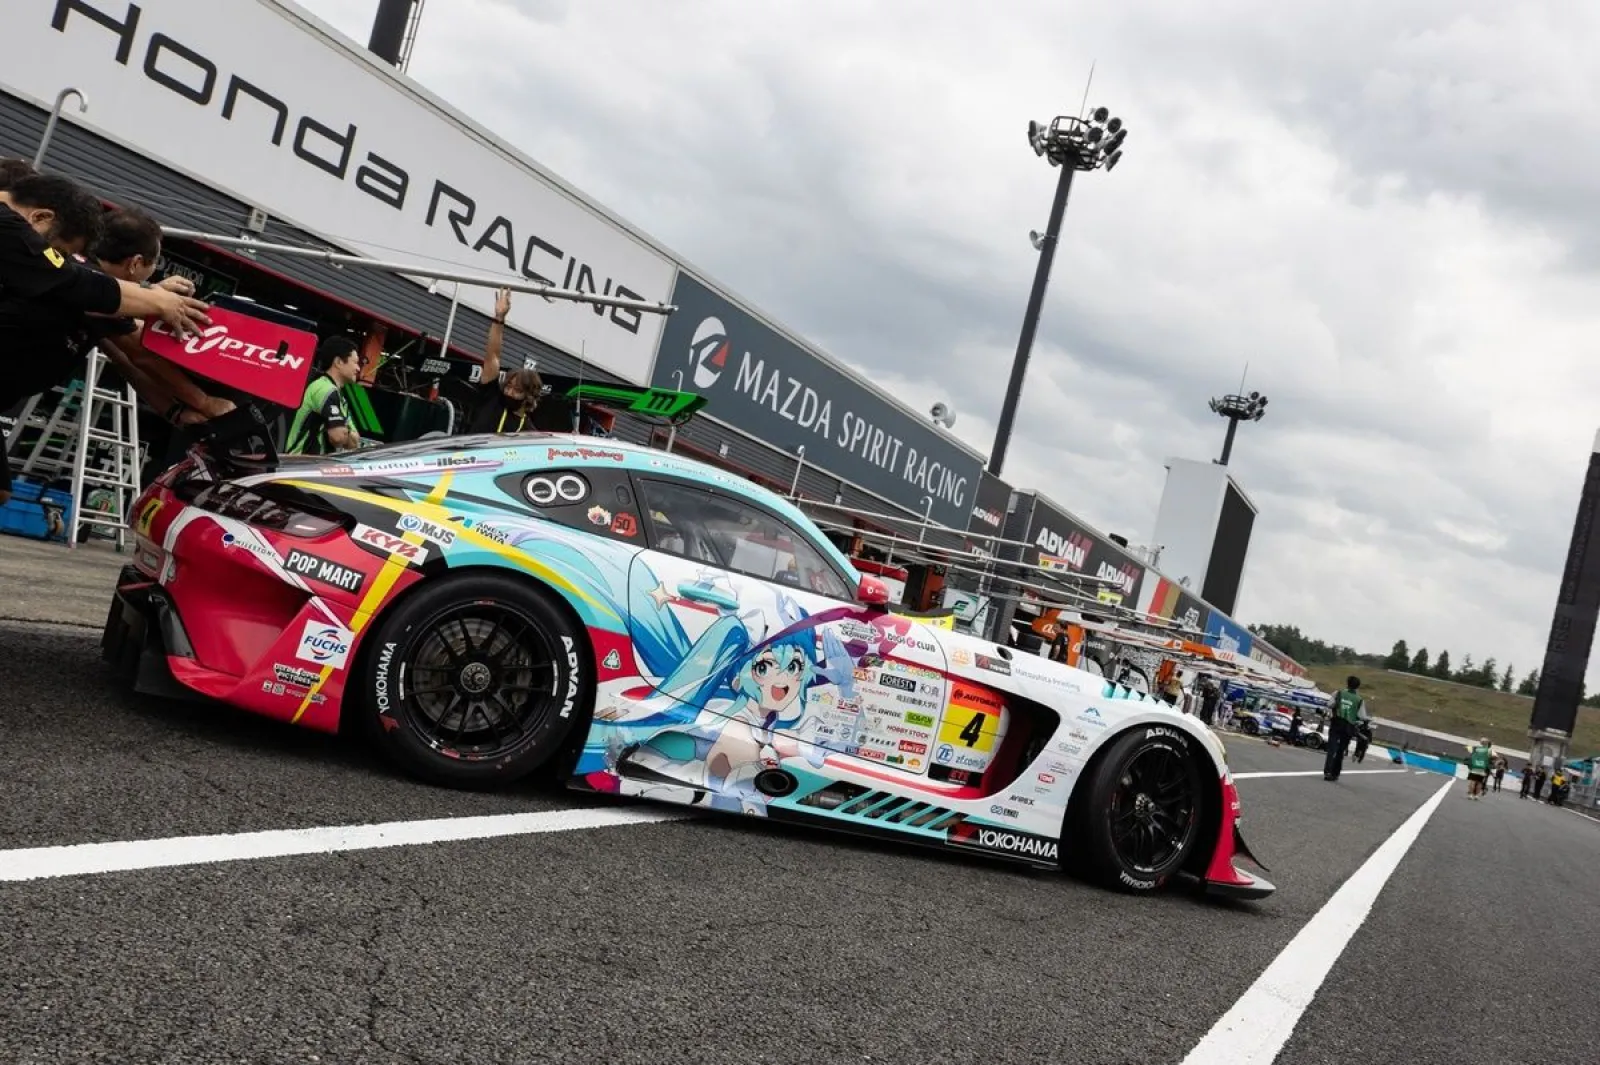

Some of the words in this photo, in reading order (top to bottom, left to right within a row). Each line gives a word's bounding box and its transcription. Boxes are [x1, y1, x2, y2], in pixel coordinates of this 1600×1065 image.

[52, 0, 409, 211] Honda
[425, 180, 646, 334] RACING
[733, 350, 832, 439] MAZDA
[837, 410, 903, 475] SPIRIT
[902, 447, 968, 509] RACING
[420, 522, 456, 545] MJS
[615, 516, 631, 531] 50
[972, 506, 1002, 528] ADVAN
[361, 528, 419, 558] KYB
[1035, 526, 1086, 569] ADVAN
[287, 551, 317, 578] POP
[318, 560, 362, 590] MART
[1095, 560, 1136, 595] ADVAN
[303, 635, 348, 654] FUCHS
[375, 642, 397, 714] YOKOHAMA
[560, 635, 580, 719] ADVAN
[908, 729, 930, 739] STOCK
[959, 711, 987, 748] 4
[1145, 727, 1189, 749] ADVAN
[978, 828, 1059, 859] YOKOHAMA
